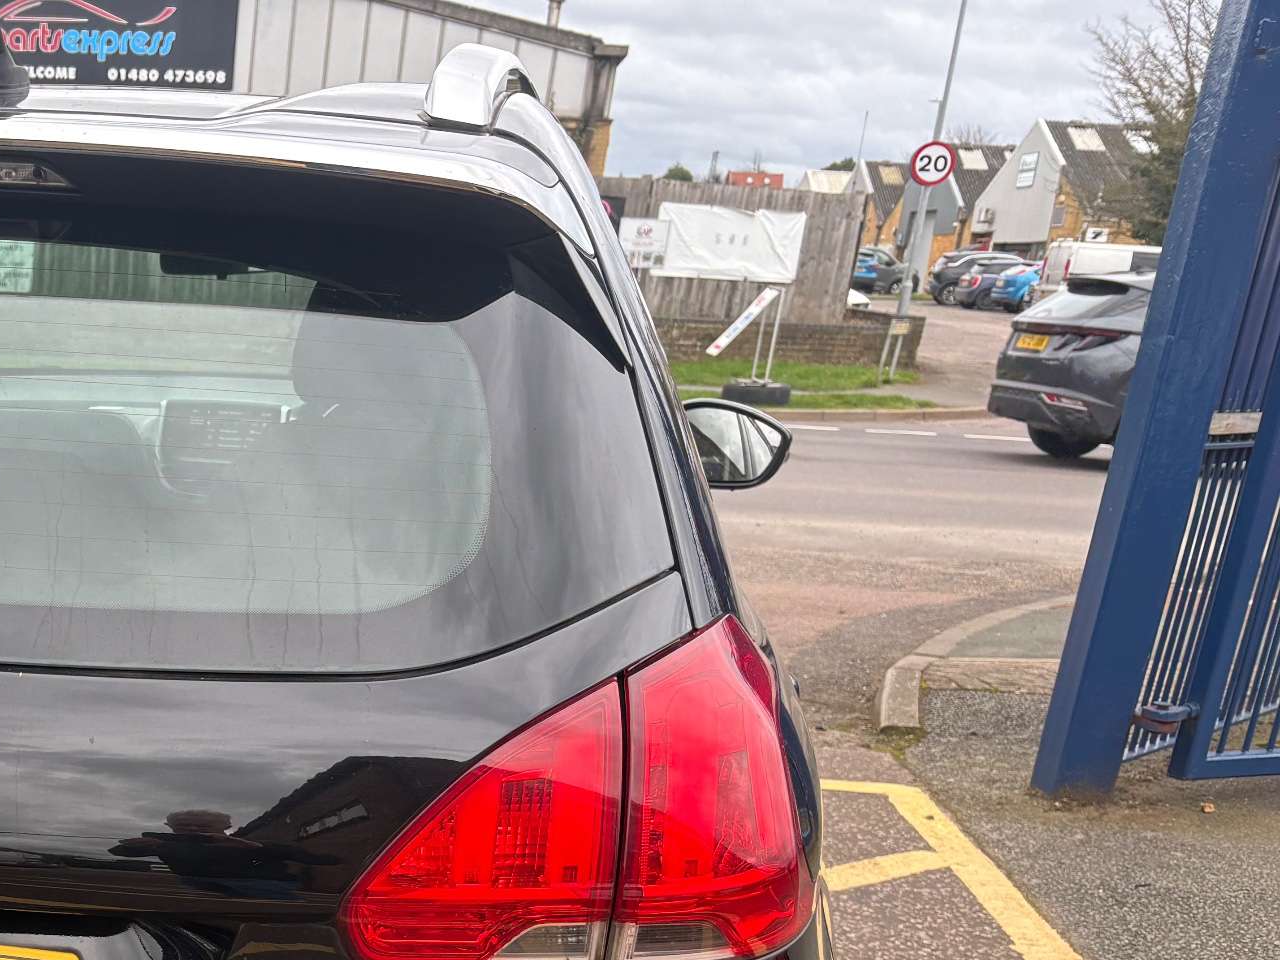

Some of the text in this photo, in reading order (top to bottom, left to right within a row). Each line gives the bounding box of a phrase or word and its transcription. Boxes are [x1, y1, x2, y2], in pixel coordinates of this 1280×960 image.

[22, 65, 77, 79] LCOME
[107, 67, 159, 82] 01480
[163, 69, 227, 84] 473698
[918, 155, 948, 172] 20
[1091, 231, 1104, 239] 7
